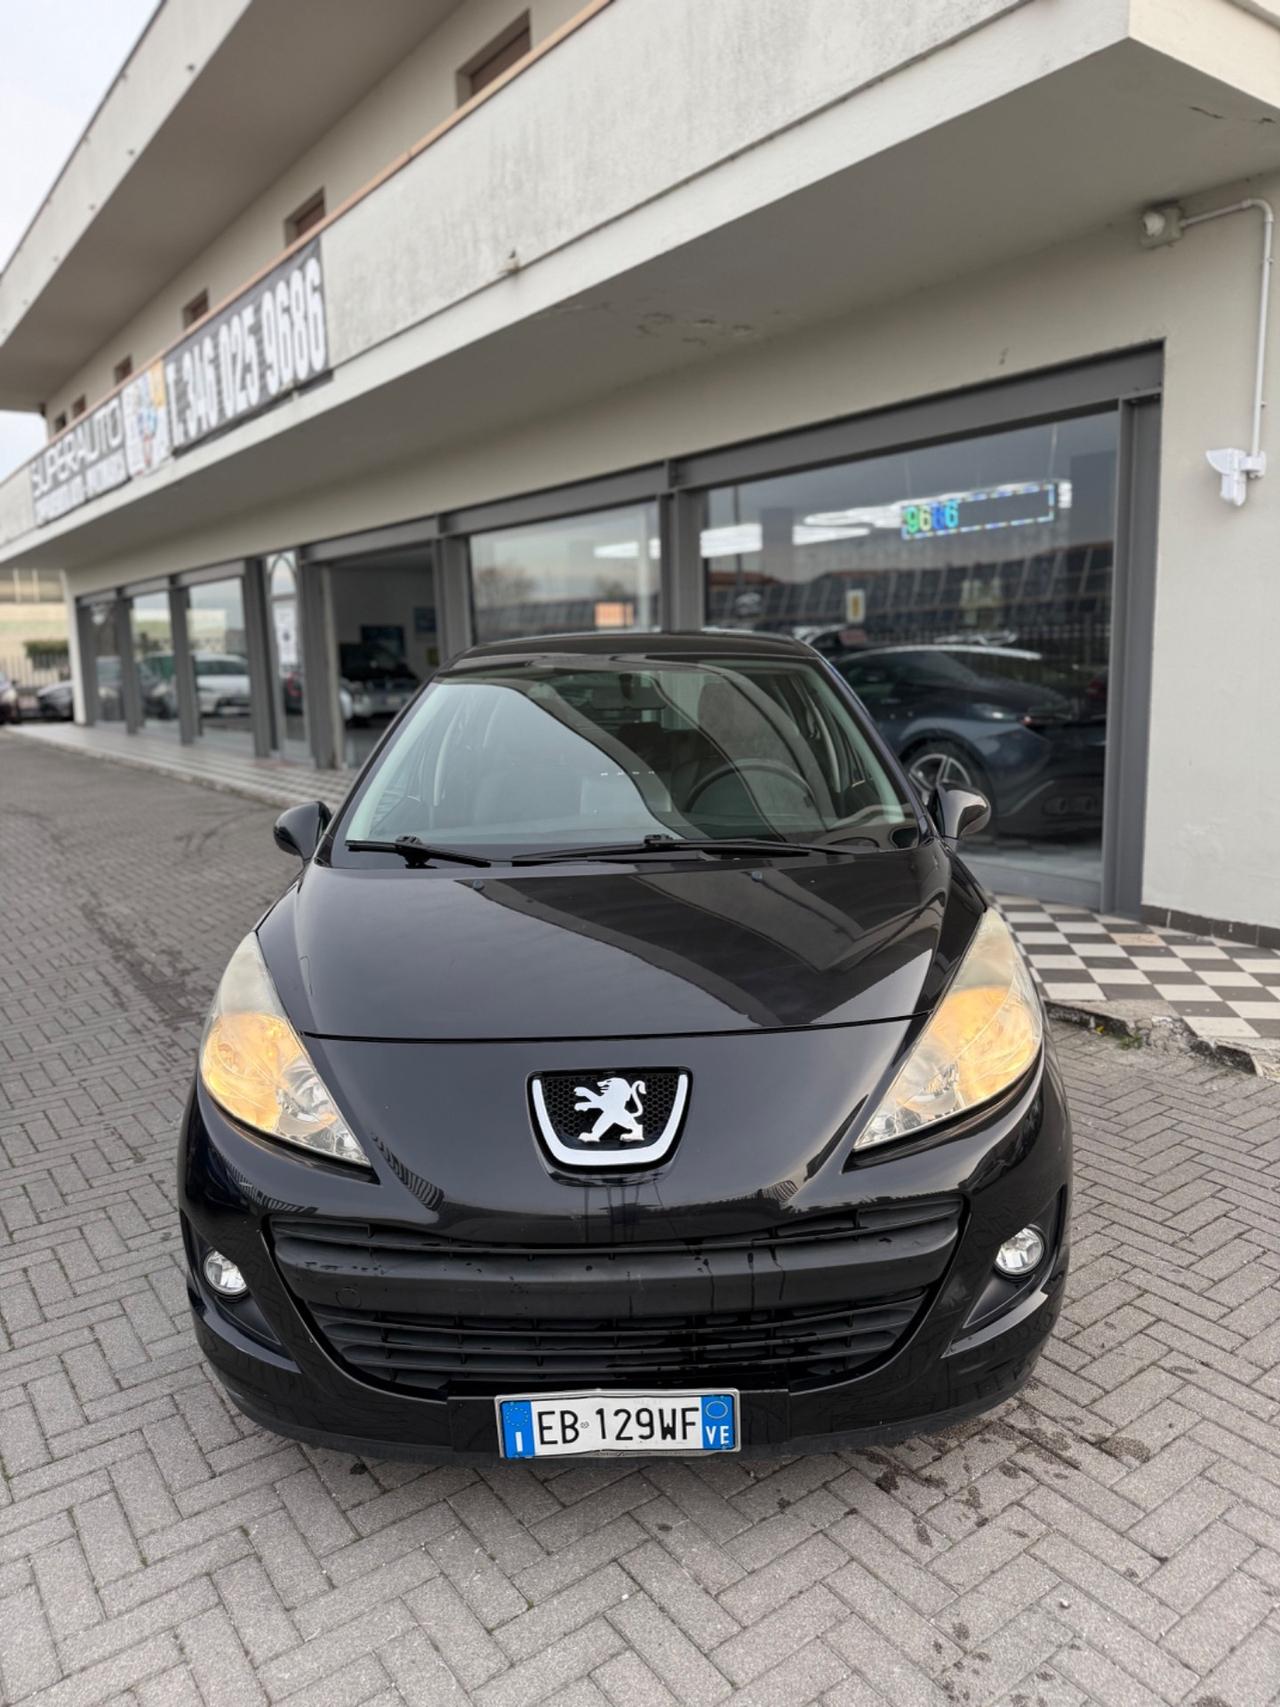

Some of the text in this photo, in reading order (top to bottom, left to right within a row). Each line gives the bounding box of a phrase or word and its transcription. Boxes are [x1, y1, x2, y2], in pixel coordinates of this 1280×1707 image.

[182, 336, 219, 437] 346
[218, 304, 260, 418] 025
[262, 257, 326, 395] 9686
[537, 1406, 699, 1445] EB 129WF
[706, 1425, 729, 1445] VE
